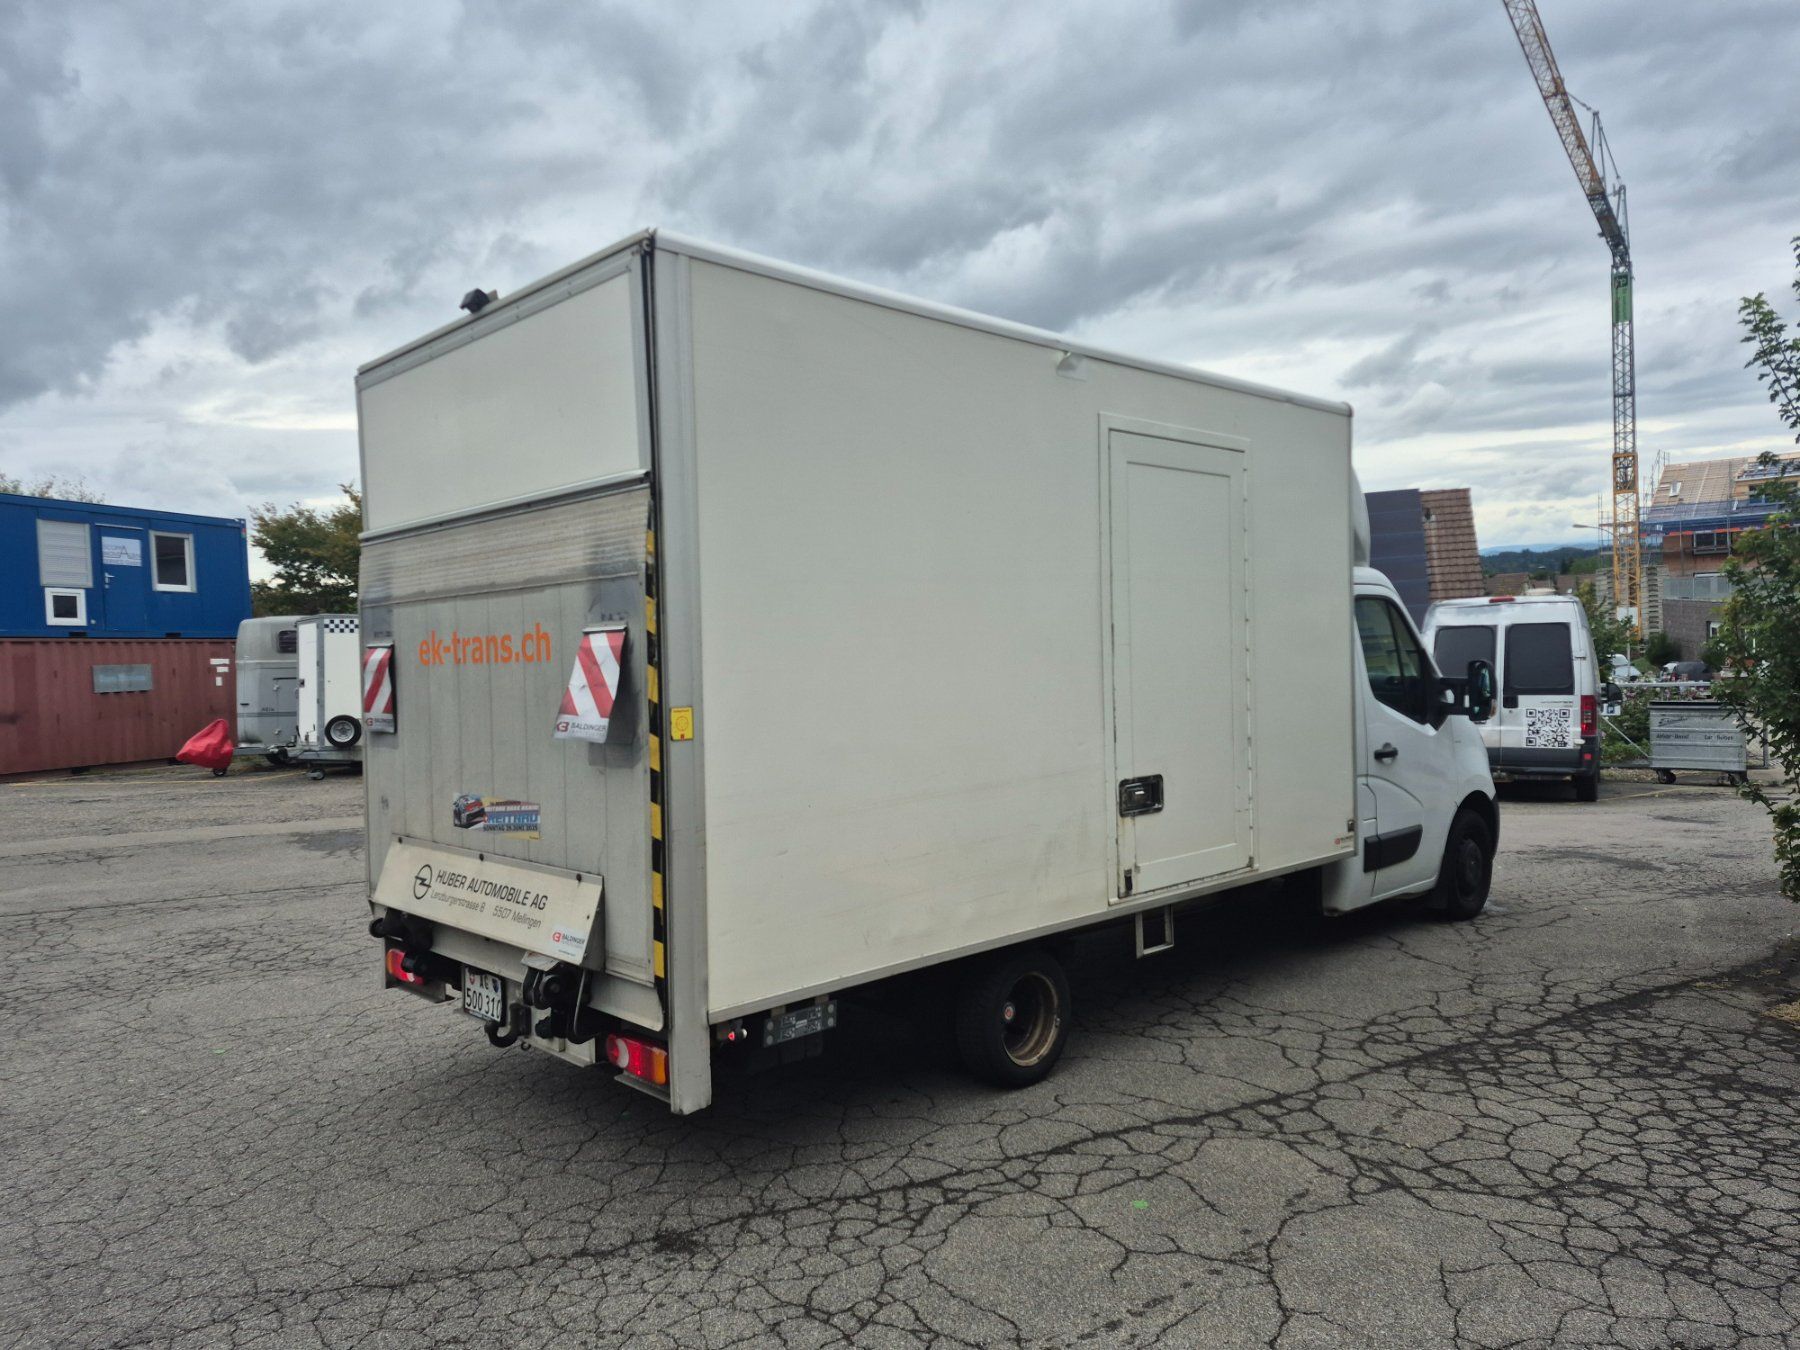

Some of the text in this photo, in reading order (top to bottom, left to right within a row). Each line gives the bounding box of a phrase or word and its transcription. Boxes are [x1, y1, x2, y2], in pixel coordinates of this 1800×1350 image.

[418, 622, 552, 667] ek-trans.ch
[435, 870, 549, 911] HUBER AUTOMOBILE AG
[493, 905, 511, 919] 5507
[511, 909, 542, 930] Mellingen
[466, 987, 483, 1012] 500
